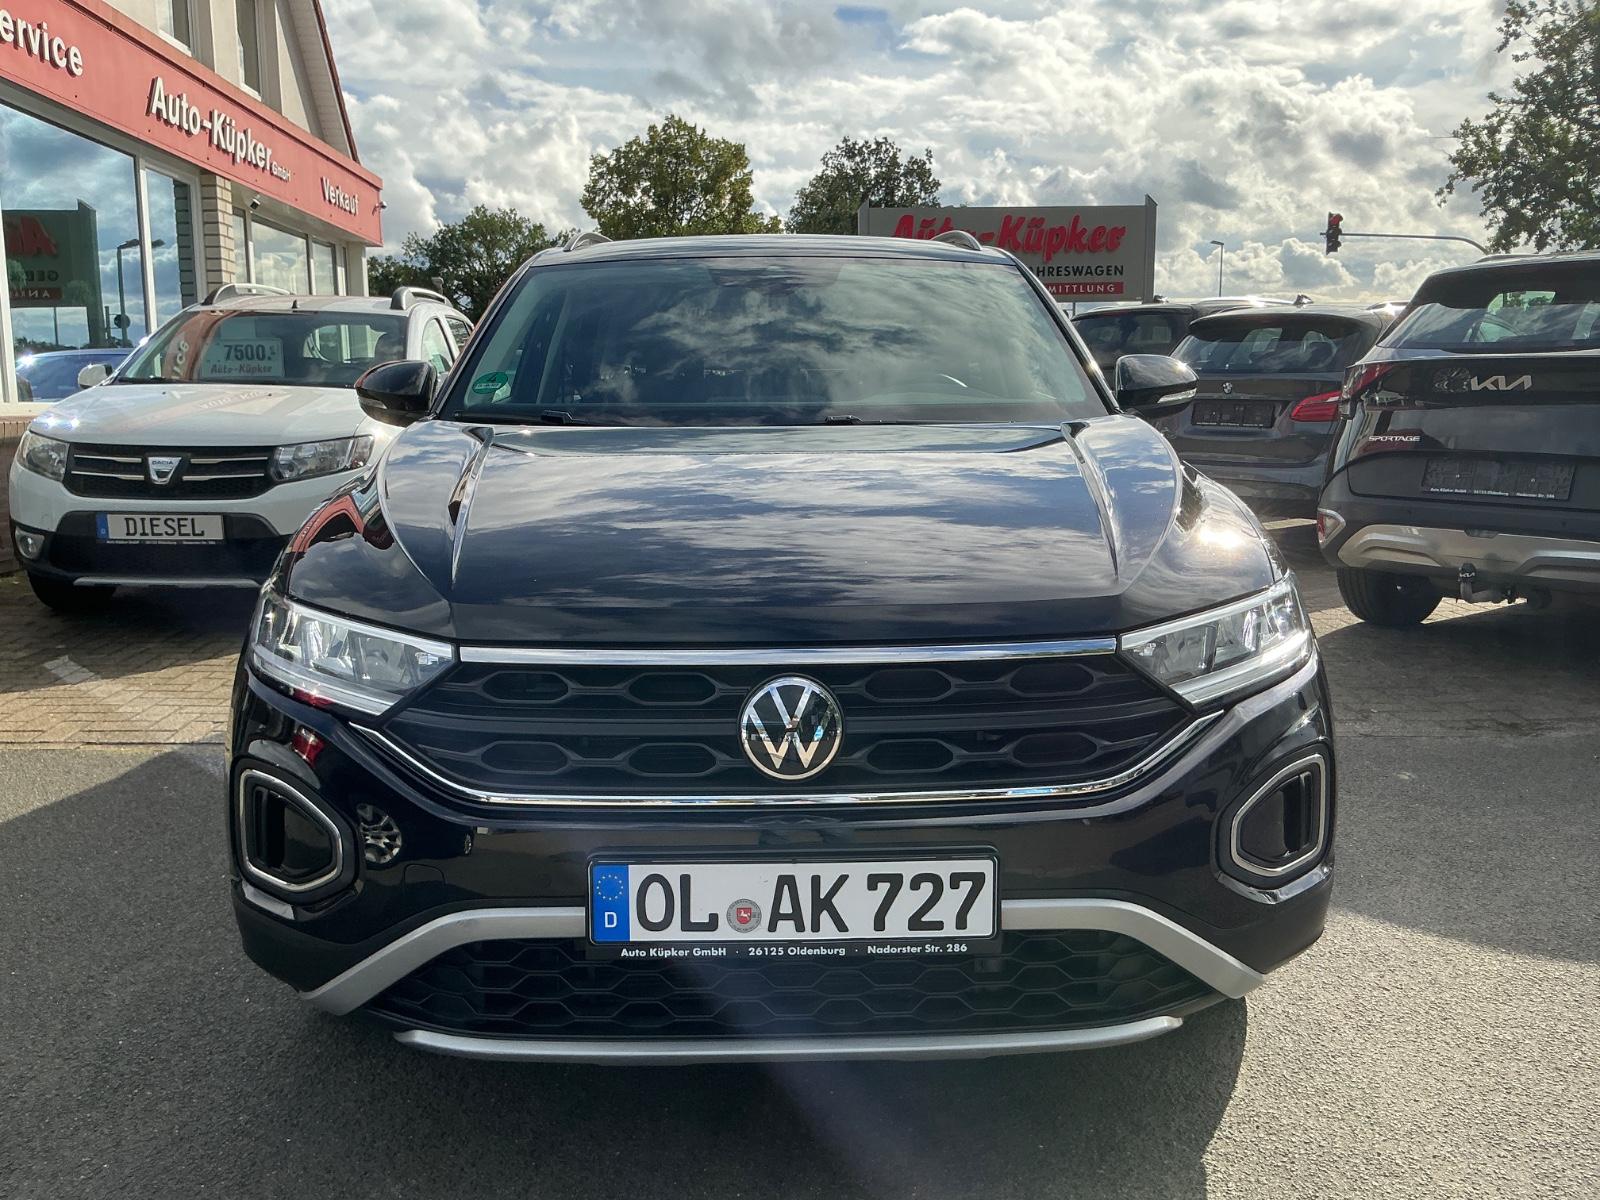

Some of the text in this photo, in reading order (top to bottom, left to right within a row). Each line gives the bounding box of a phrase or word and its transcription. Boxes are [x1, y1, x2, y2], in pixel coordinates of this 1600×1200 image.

[149, 76, 291, 182] Auto-Küpker GmbH
[321, 175, 359, 216] Verkauf
[1470, 374, 1533, 391] KIA
[125, 517, 205, 537] DIESEL
[604, 911, 618, 929] D
[636, 873, 719, 933] OL
[767, 874, 850, 933] AK
[866, 871, 986, 932] 727
[620, 943, 968, 958] Auto Küpker GmbH 26125 Oldenburg Nadorster Str. 286
